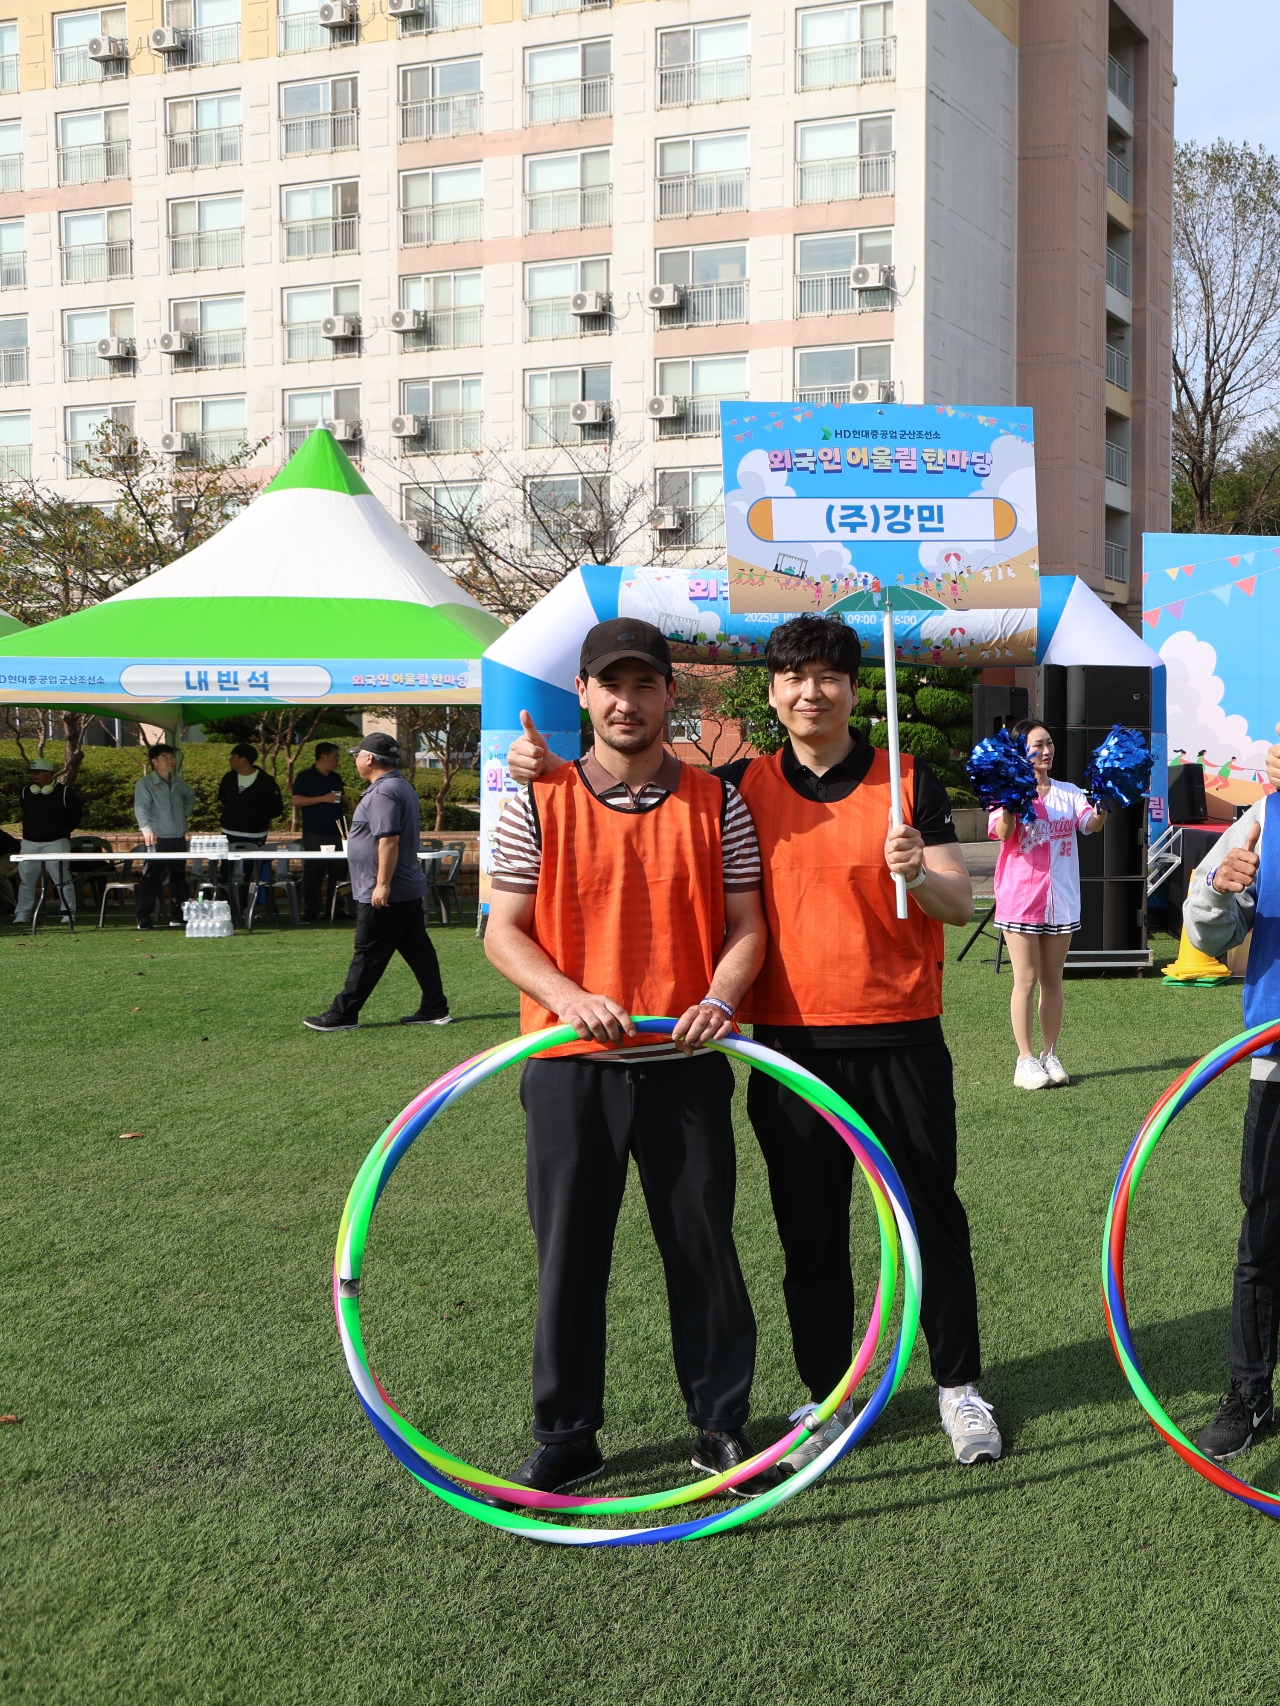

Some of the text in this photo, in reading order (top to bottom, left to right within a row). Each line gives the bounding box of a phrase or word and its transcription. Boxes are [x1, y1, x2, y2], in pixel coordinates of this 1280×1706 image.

[834, 429, 941, 440] HD현대중공업 군산조선소
[767, 446, 994, 478] 외국인 어울림 한마당
[825, 503, 945, 534] (주)강민
[847, 614, 877, 625] 09:00
[893, 614, 917, 625] 6:00
[0, 674, 106, 685] D현대중공업 군산조선소
[352, 673, 469, 688] 외국인 어울림 한마당
